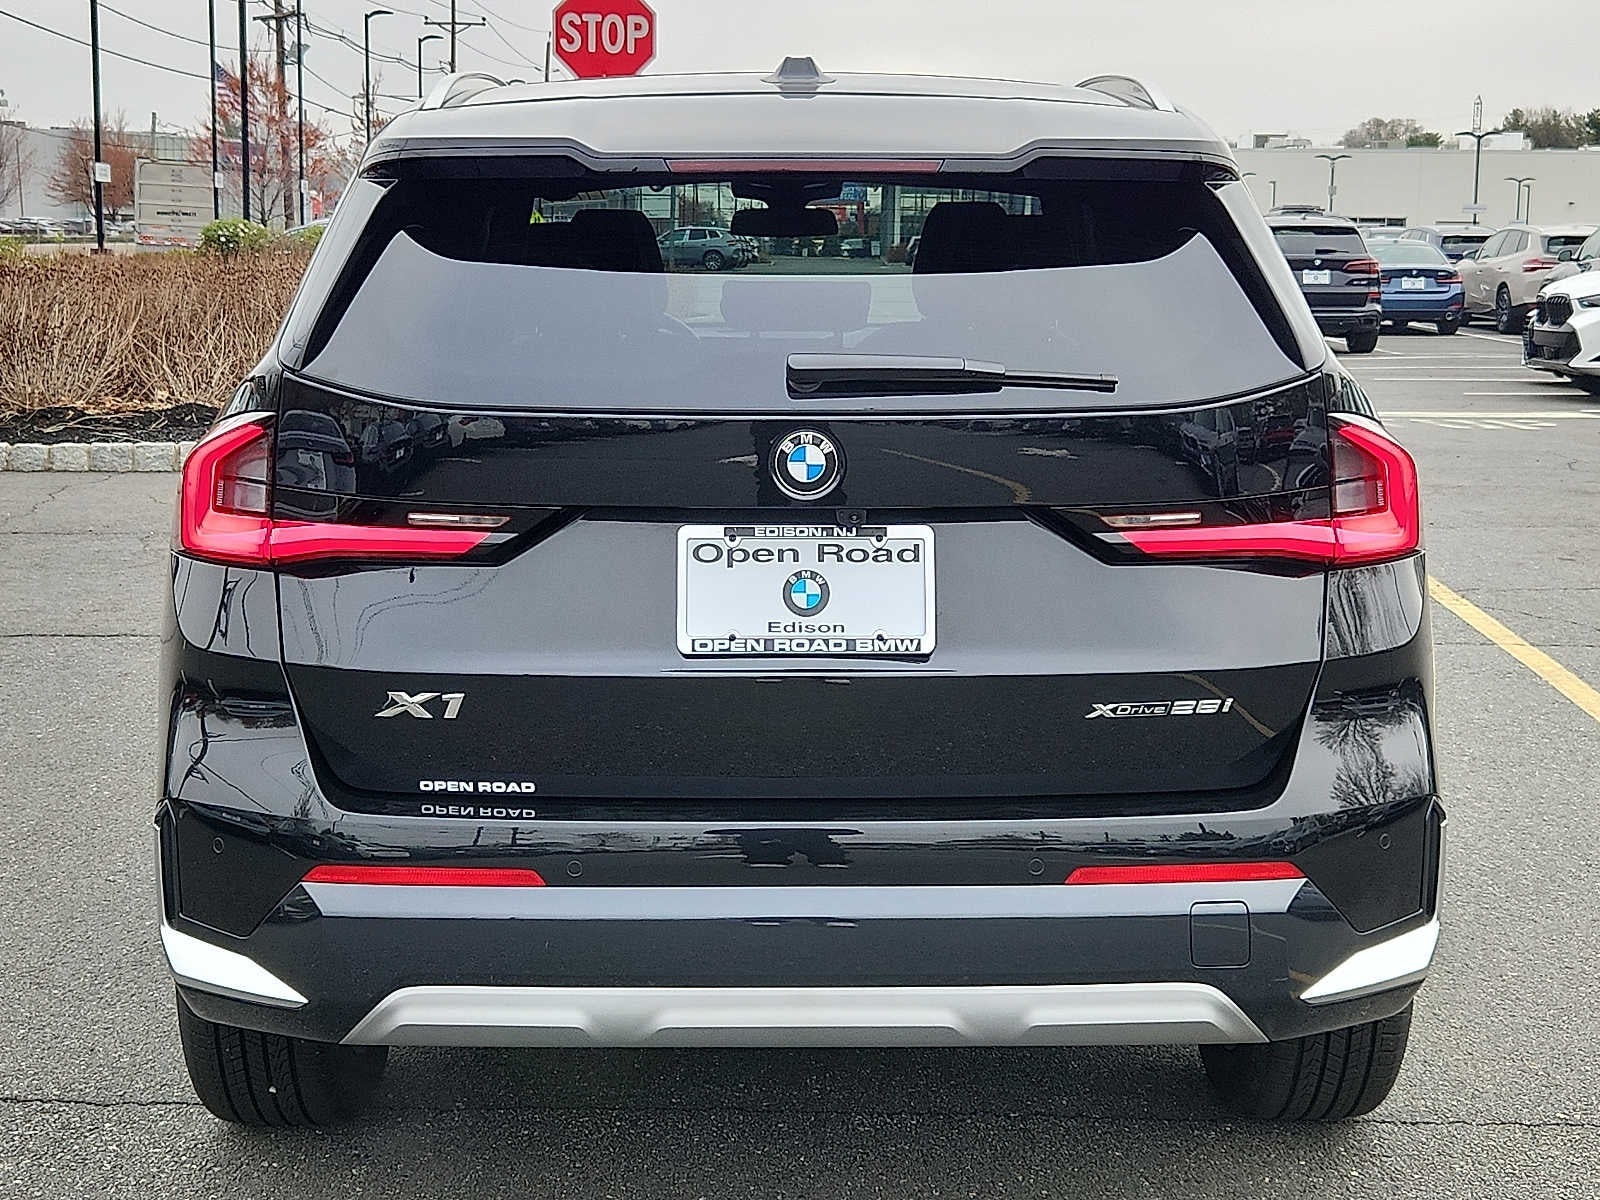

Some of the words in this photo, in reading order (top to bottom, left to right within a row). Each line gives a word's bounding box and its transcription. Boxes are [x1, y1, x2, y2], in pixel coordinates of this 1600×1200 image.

[560, 12, 650, 54] STOP
[781, 433, 833, 454] BMW
[833, 527, 857, 537] NJ
[692, 543, 800, 568] Open
[817, 543, 920, 563] Road
[767, 621, 845, 633] Edison
[693, 639, 765, 652] OPEN
[774, 639, 848, 652] ROAD
[855, 639, 920, 652] BMW
[374, 691, 465, 719] X1
[419, 781, 474, 792] OPEN
[478, 781, 536, 793] ROAD
